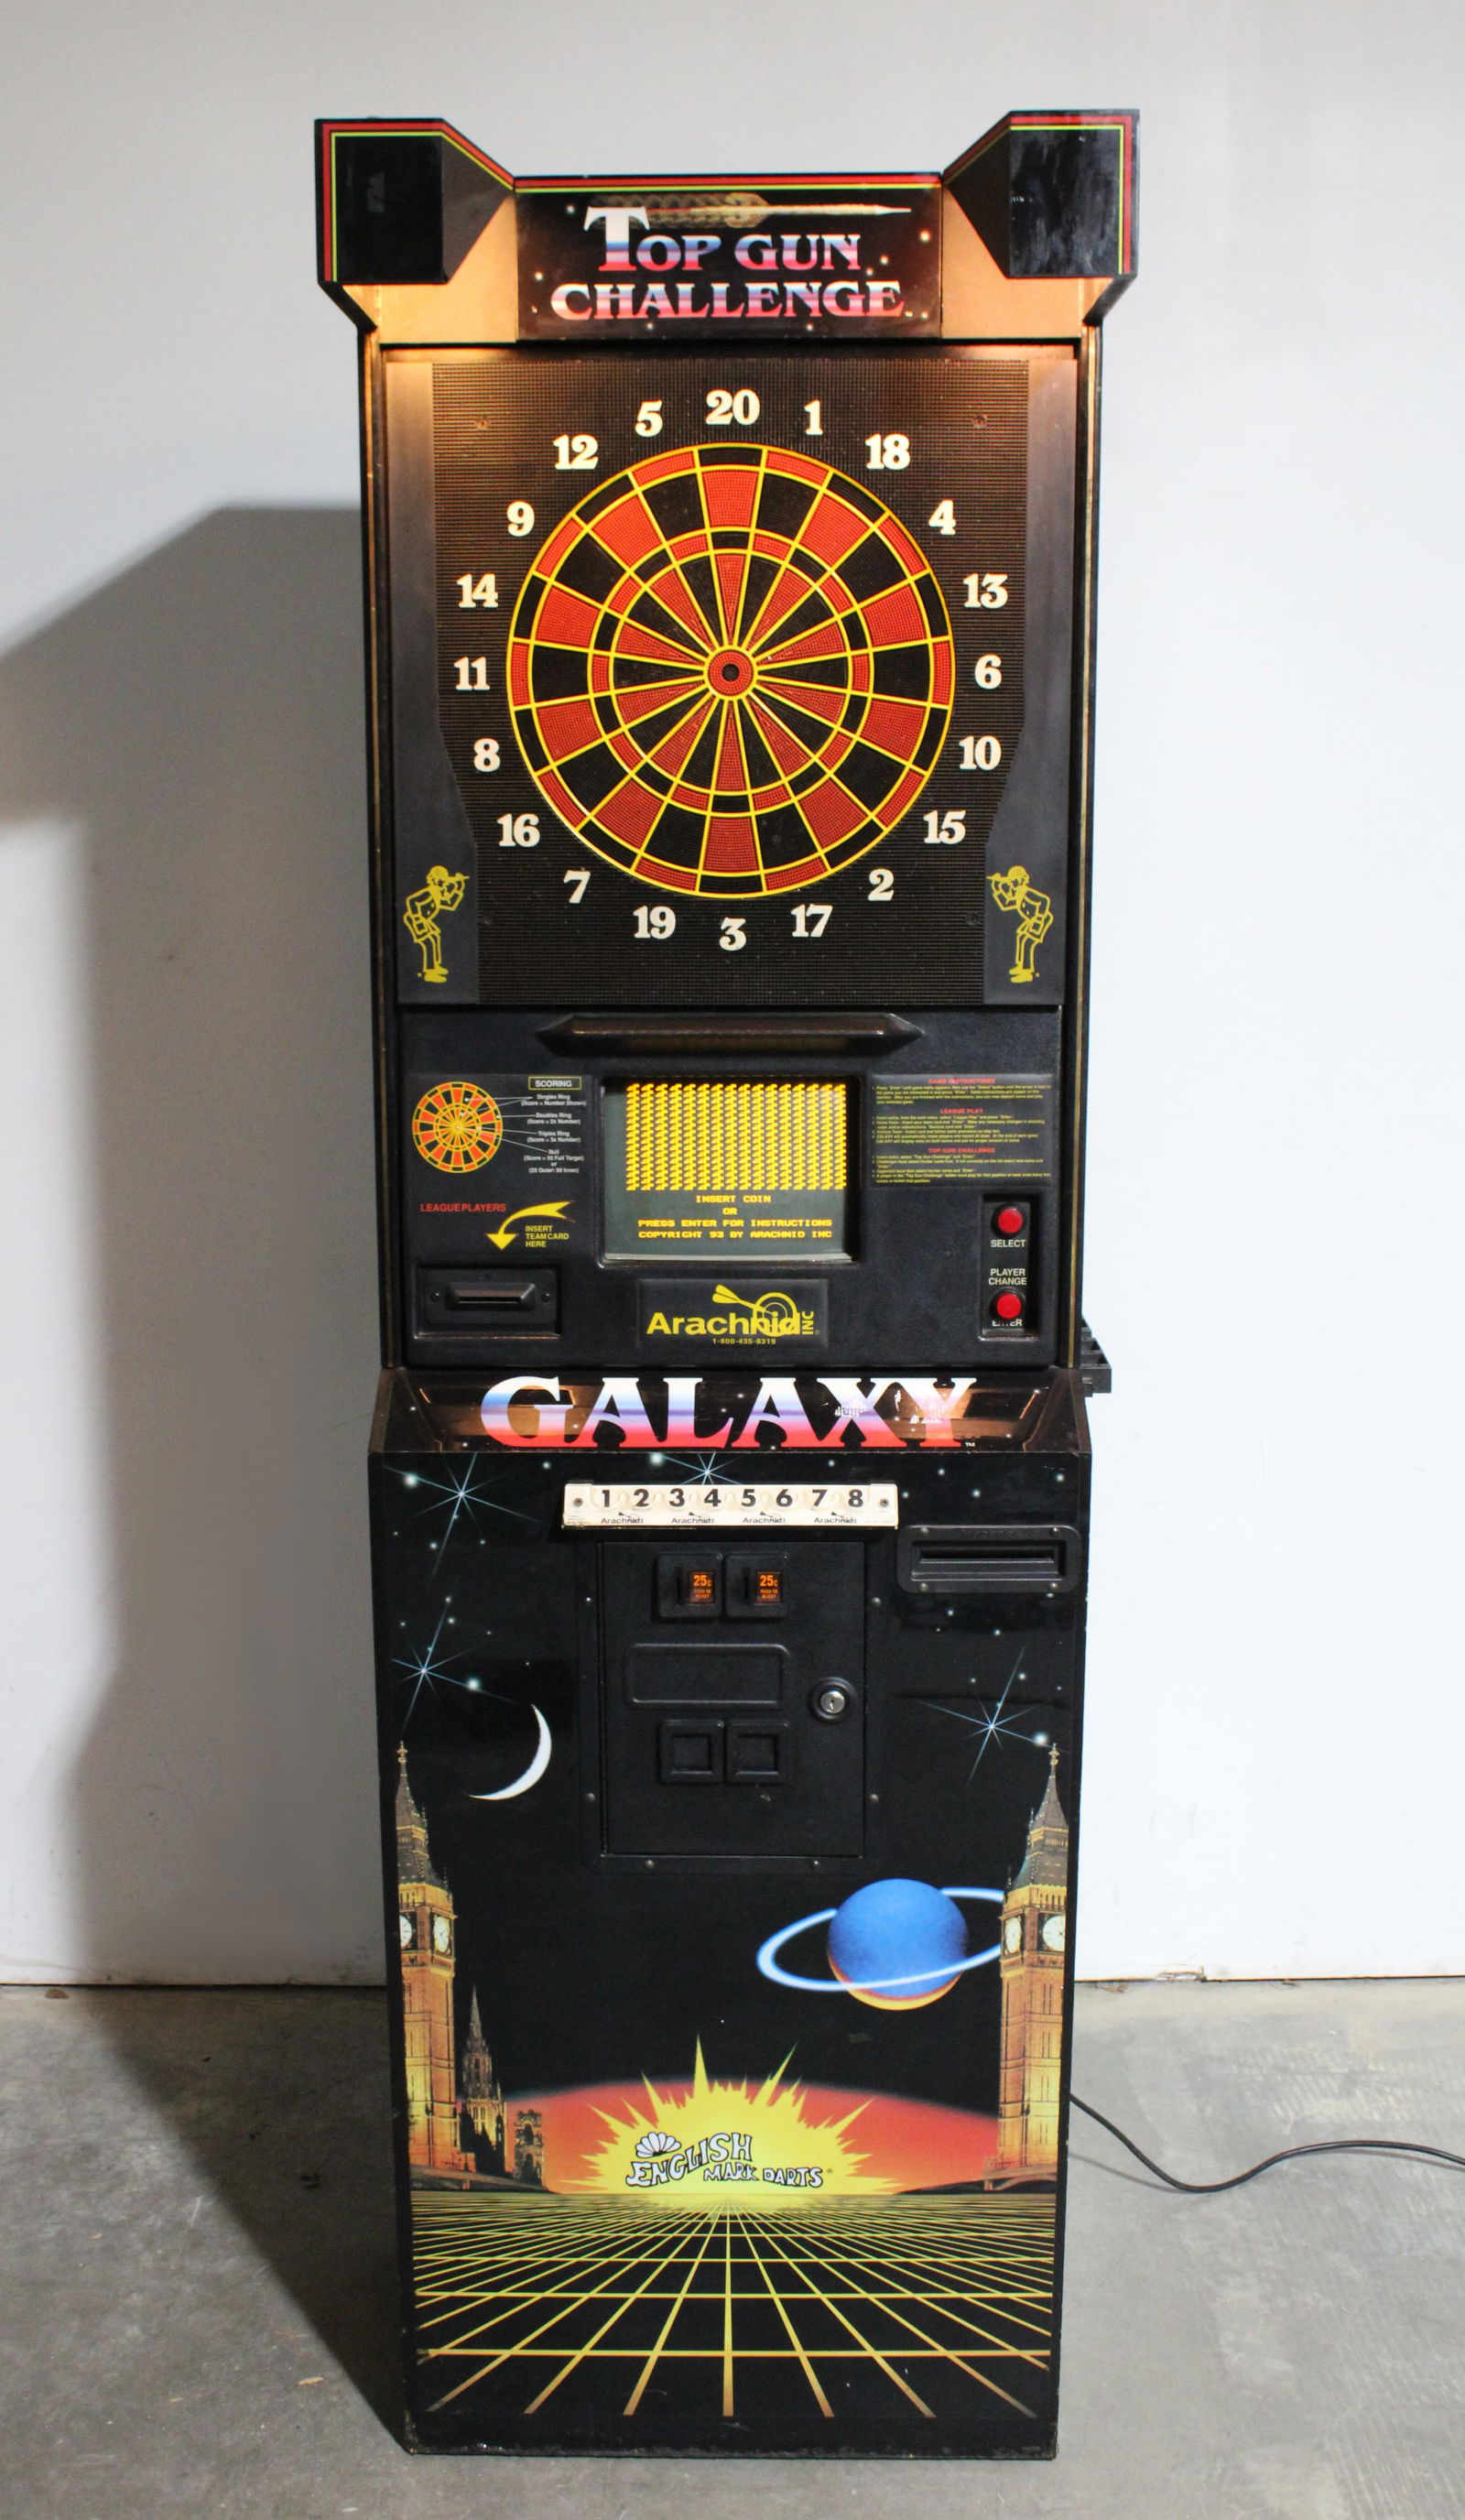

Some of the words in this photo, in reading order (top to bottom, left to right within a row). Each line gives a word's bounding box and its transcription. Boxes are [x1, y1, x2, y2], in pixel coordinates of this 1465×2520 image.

[583, 206, 722, 271] TOP
[733, 234, 861, 271] GUN
[550, 279, 905, 320] CHALLENGE
[635, 401, 662, 437] 5
[706, 391, 759, 425] 20
[805, 401, 823, 435] 1
[554, 435, 598, 470] 12
[865, 435, 910, 470] 18
[506, 502, 534, 537] 9
[929, 501, 956, 535] 4
[457, 575, 498, 608] 14
[964, 575, 1007, 608] 13
[455, 657, 490, 690] 11
[975, 656, 1001, 690] 6
[474, 739, 500, 772] 8
[960, 736, 1001, 770] 10
[498, 814, 540, 847] 16
[924, 811, 966, 844] 15
[564, 871, 591, 904] 7
[868, 869, 894, 901] 2
[634, 907, 676, 940] 19
[720, 918, 746, 950] 3
[791, 905, 832, 938] 17
[535, 1080, 572, 1088] SCORING
[420, 1203, 460, 1211] LEAGUE
[461, 1203, 506, 1211] PLAYERS
[696, 1195, 735, 1203] INSERT
[722, 1207, 737, 1215] OR
[751, 1219, 832, 1227] INSTRUCTIONS
[991, 1240, 1026, 1248] SELECT
[988, 1276, 1027, 1286] CHANGE
[990, 1268, 1026, 1276] PLAYER
[646, 1310, 800, 1335] Arachnid
[801, 1311, 814, 1335] INC
[480, 1376, 977, 1450] GALAXY
[602, 1490, 610, 1507] 1
[634, 1489, 649, 1507] 2
[669, 1488, 685, 1507] 3
[704, 1489, 722, 1507] 4
[741, 1489, 756, 1507] 5
[776, 1489, 793, 1507] 6
[812, 1489, 828, 1507] 7
[848, 1489, 863, 1507] 8
[625, 2132, 753, 2188] ENGLISH
[703, 2162, 759, 2181] MARK
[763, 2167, 823, 2188] DARTS
